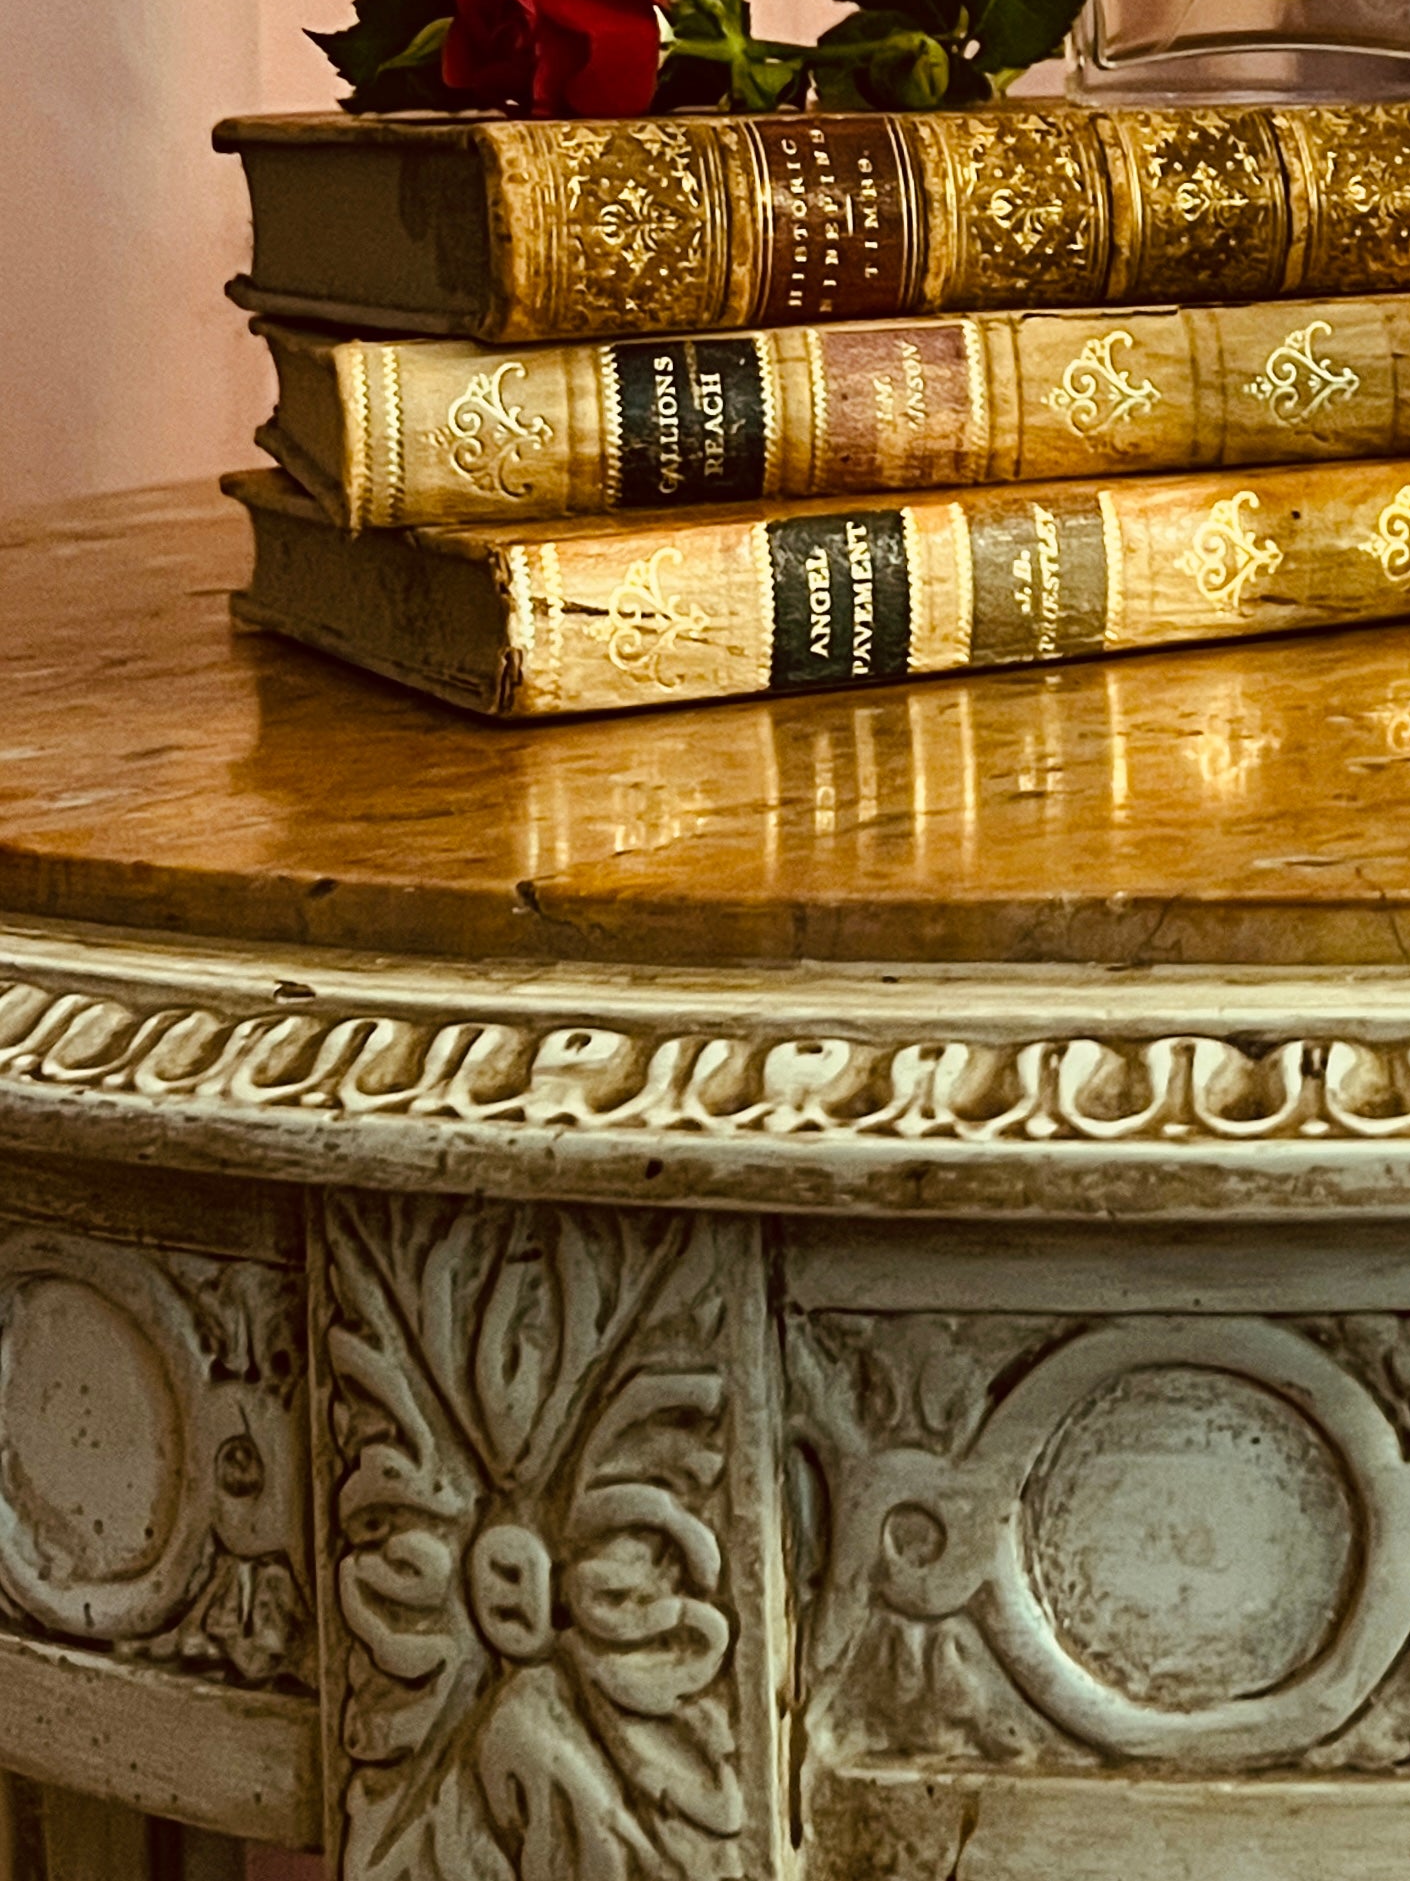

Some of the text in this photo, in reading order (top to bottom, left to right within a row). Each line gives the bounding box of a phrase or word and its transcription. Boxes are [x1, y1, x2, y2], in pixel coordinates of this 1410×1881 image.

[781, 138, 809, 307] HISTORIC
[654, 356, 685, 495] GALLIONS
[700, 373, 725, 477] REACH
[806, 546, 831, 658] ANGEL
[846, 521, 873, 675] PAVEMENT
